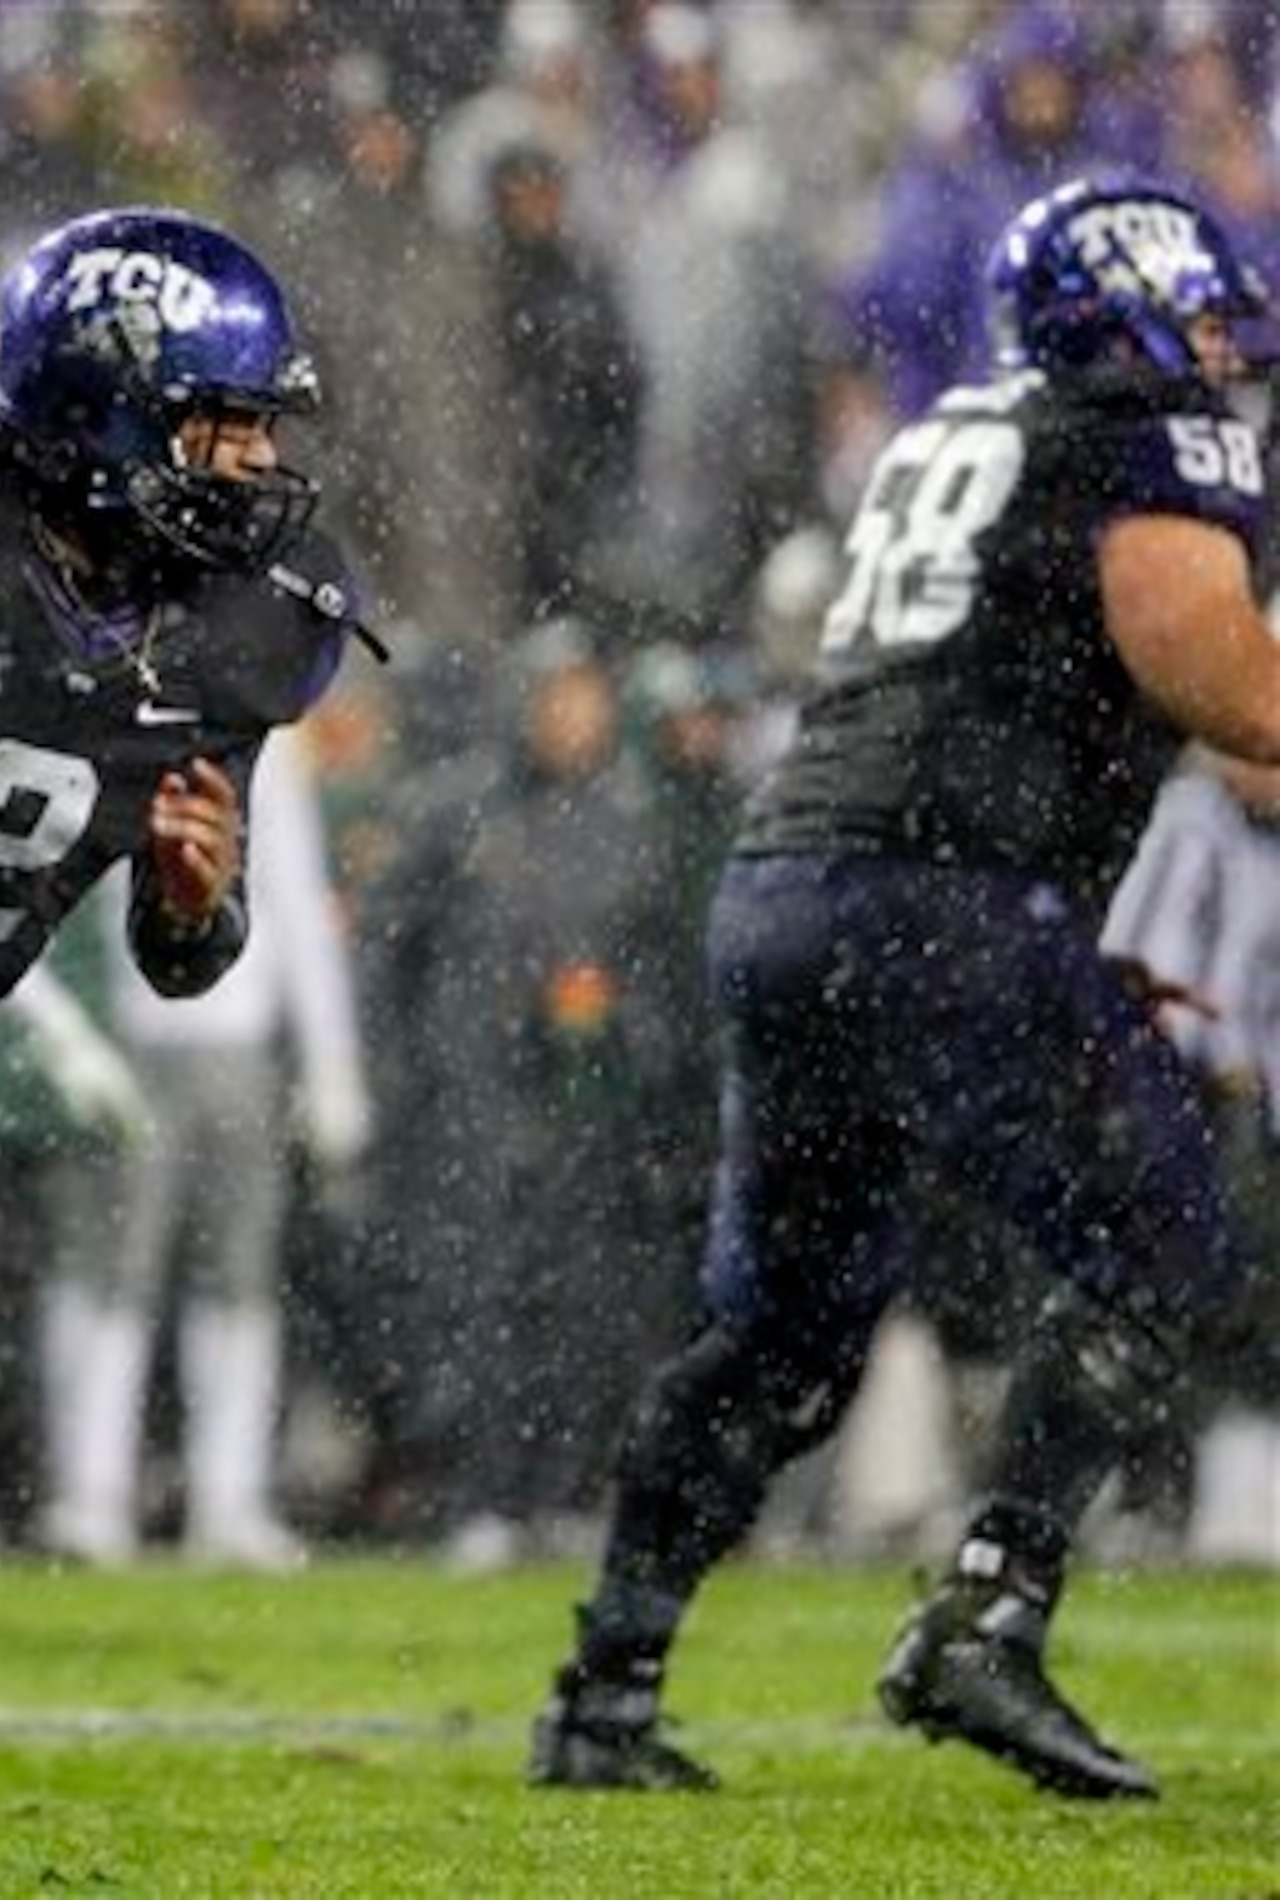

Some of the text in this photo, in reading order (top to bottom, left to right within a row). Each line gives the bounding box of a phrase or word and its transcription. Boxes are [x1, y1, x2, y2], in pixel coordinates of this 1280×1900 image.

[1067, 202, 1200, 270] TCU
[68, 248, 217, 332] TCU
[1166, 413, 1262, 496] 58
[821, 420, 1026, 648] 58
